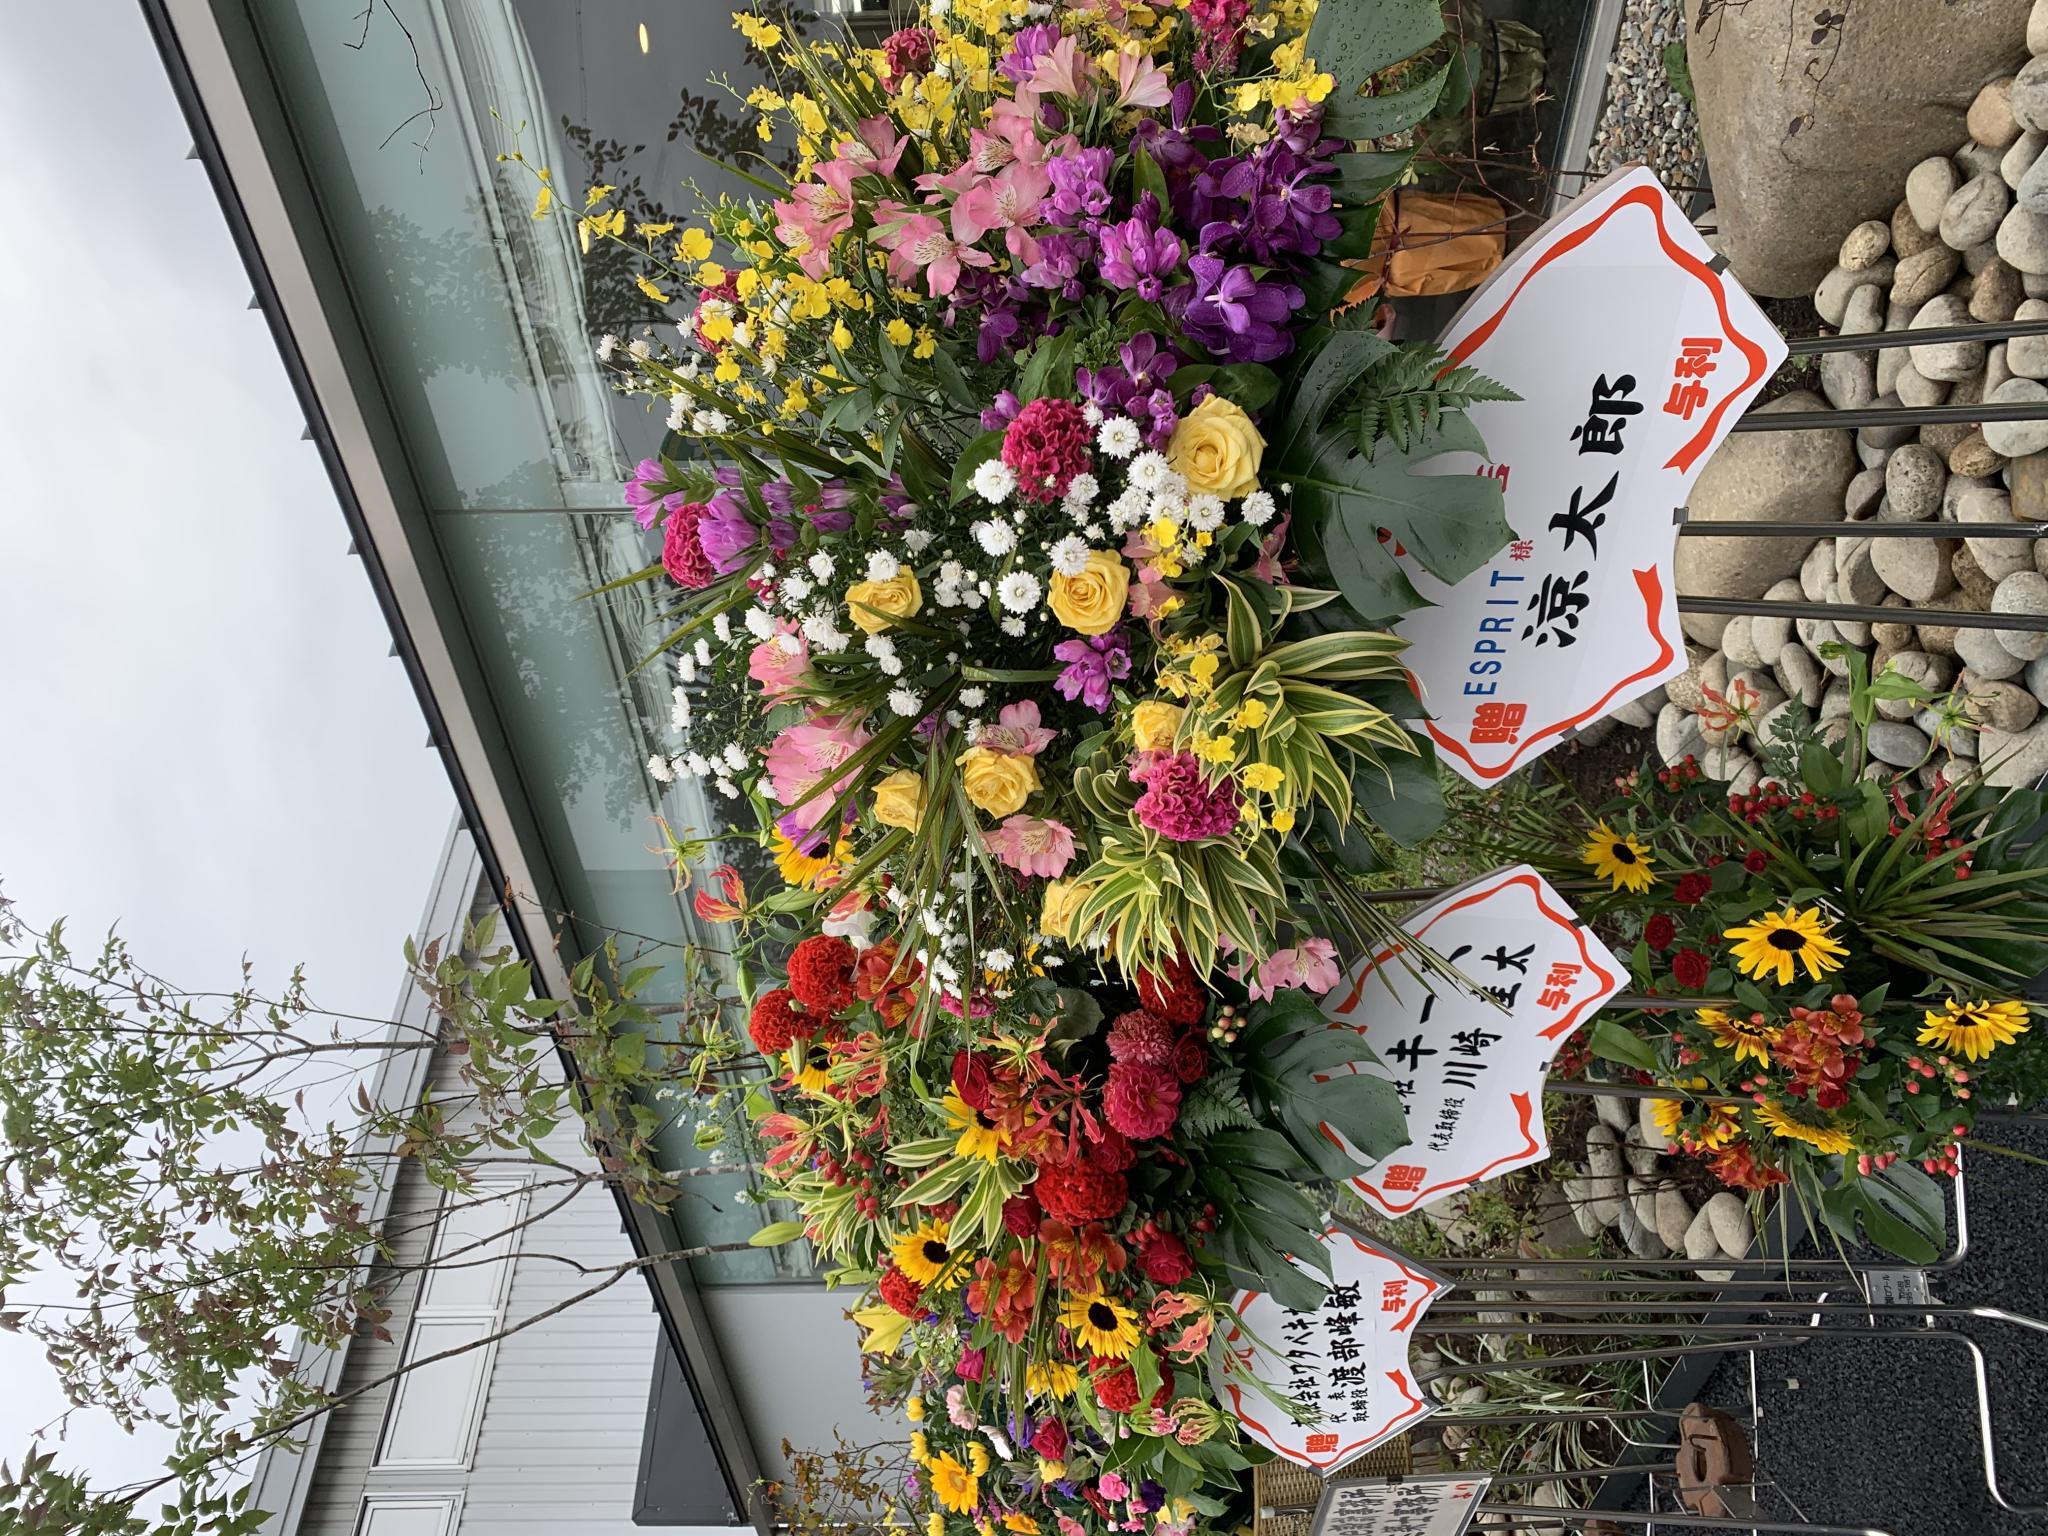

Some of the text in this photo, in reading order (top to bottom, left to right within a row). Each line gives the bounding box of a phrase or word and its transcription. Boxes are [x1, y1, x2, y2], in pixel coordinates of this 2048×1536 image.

[1662, 337, 1722, 420] 与利
[1521, 373, 1644, 648] 涼太郎
[1463, 570, 1524, 696] ESPRIT
[1469, 702, 1527, 744] 贈
[1537, 963, 1582, 1010] 与利
[1427, 1098, 1465, 1151] 代表取締役
[1382, 1165, 1427, 1192] 贈
